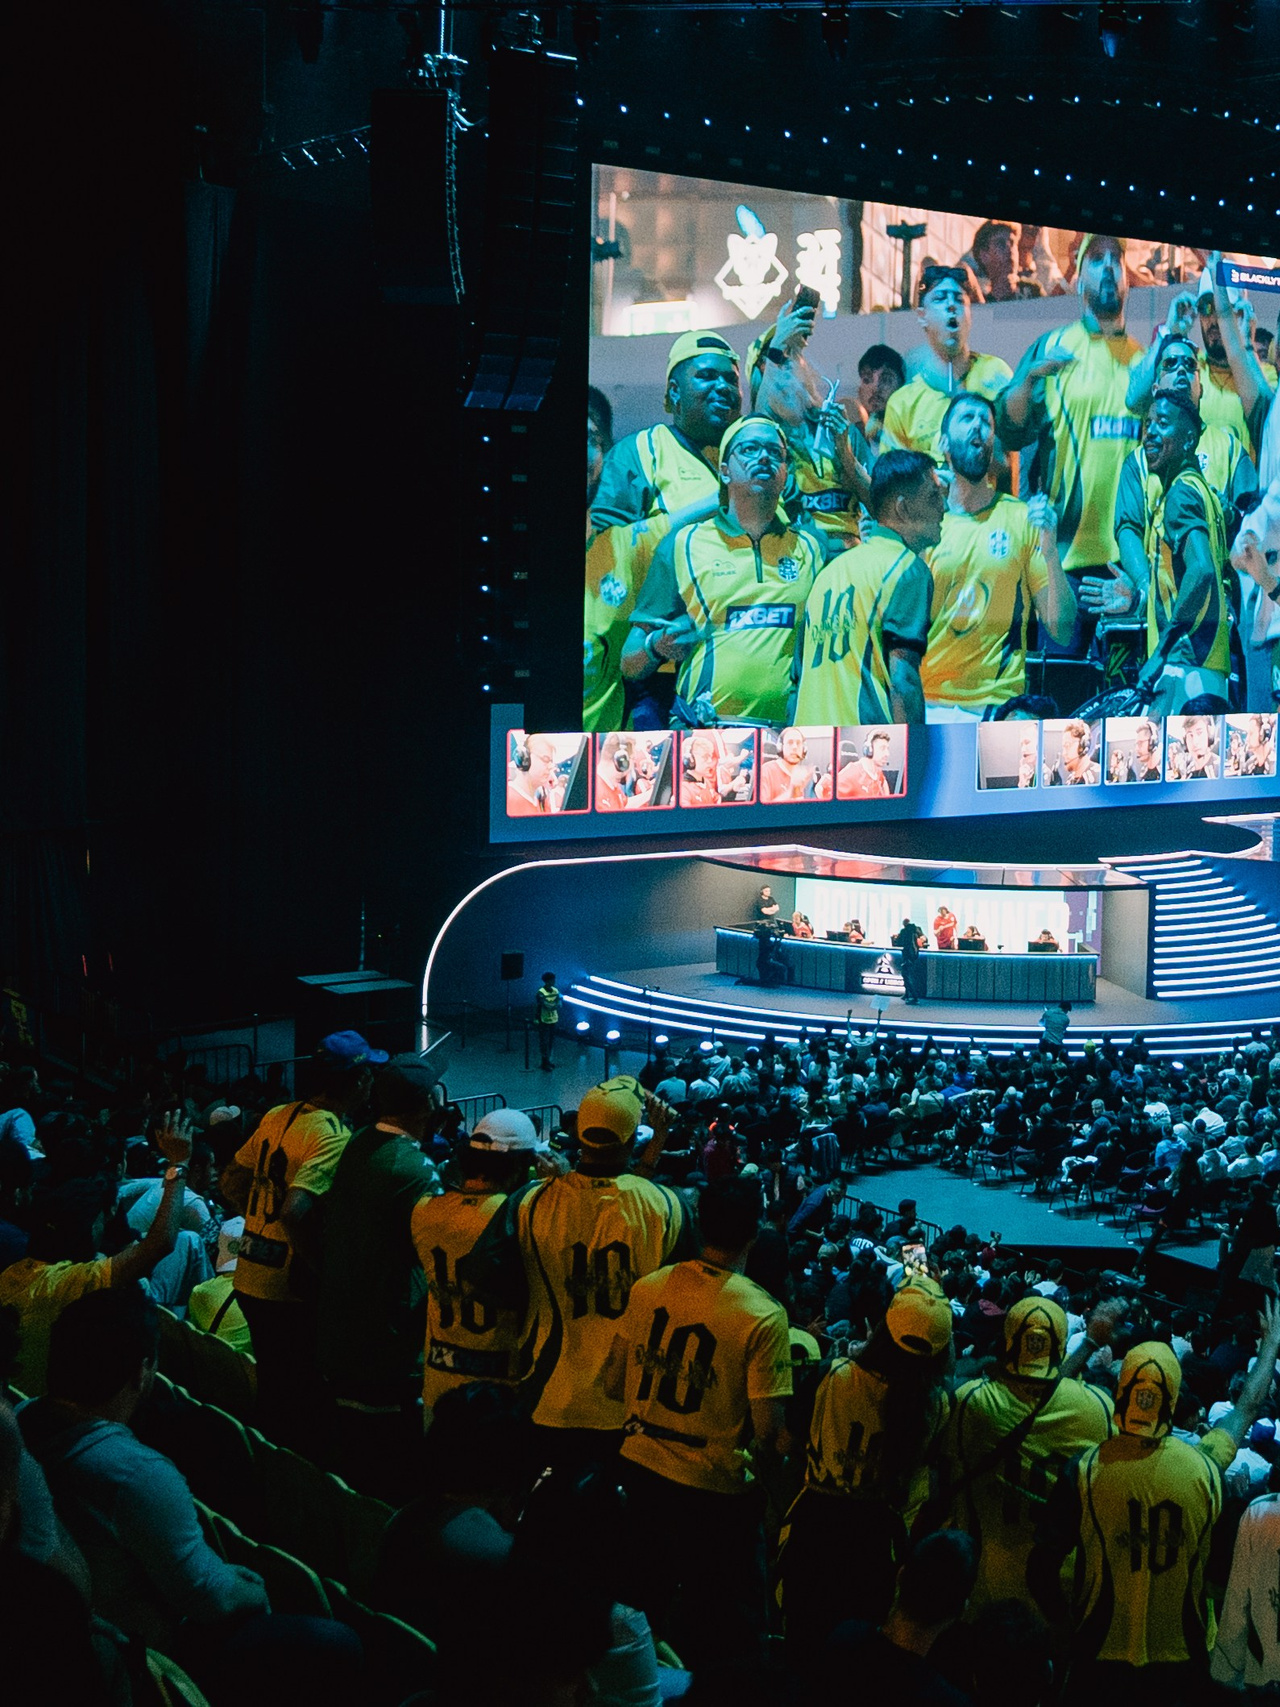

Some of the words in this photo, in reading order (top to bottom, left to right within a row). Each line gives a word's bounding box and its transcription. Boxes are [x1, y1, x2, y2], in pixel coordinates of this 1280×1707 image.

[729, 606, 793, 630] 1XBET
[572, 1240, 631, 1320] 10
[637, 1307, 717, 1414] 10
[1127, 1498, 1183, 1574] 10
